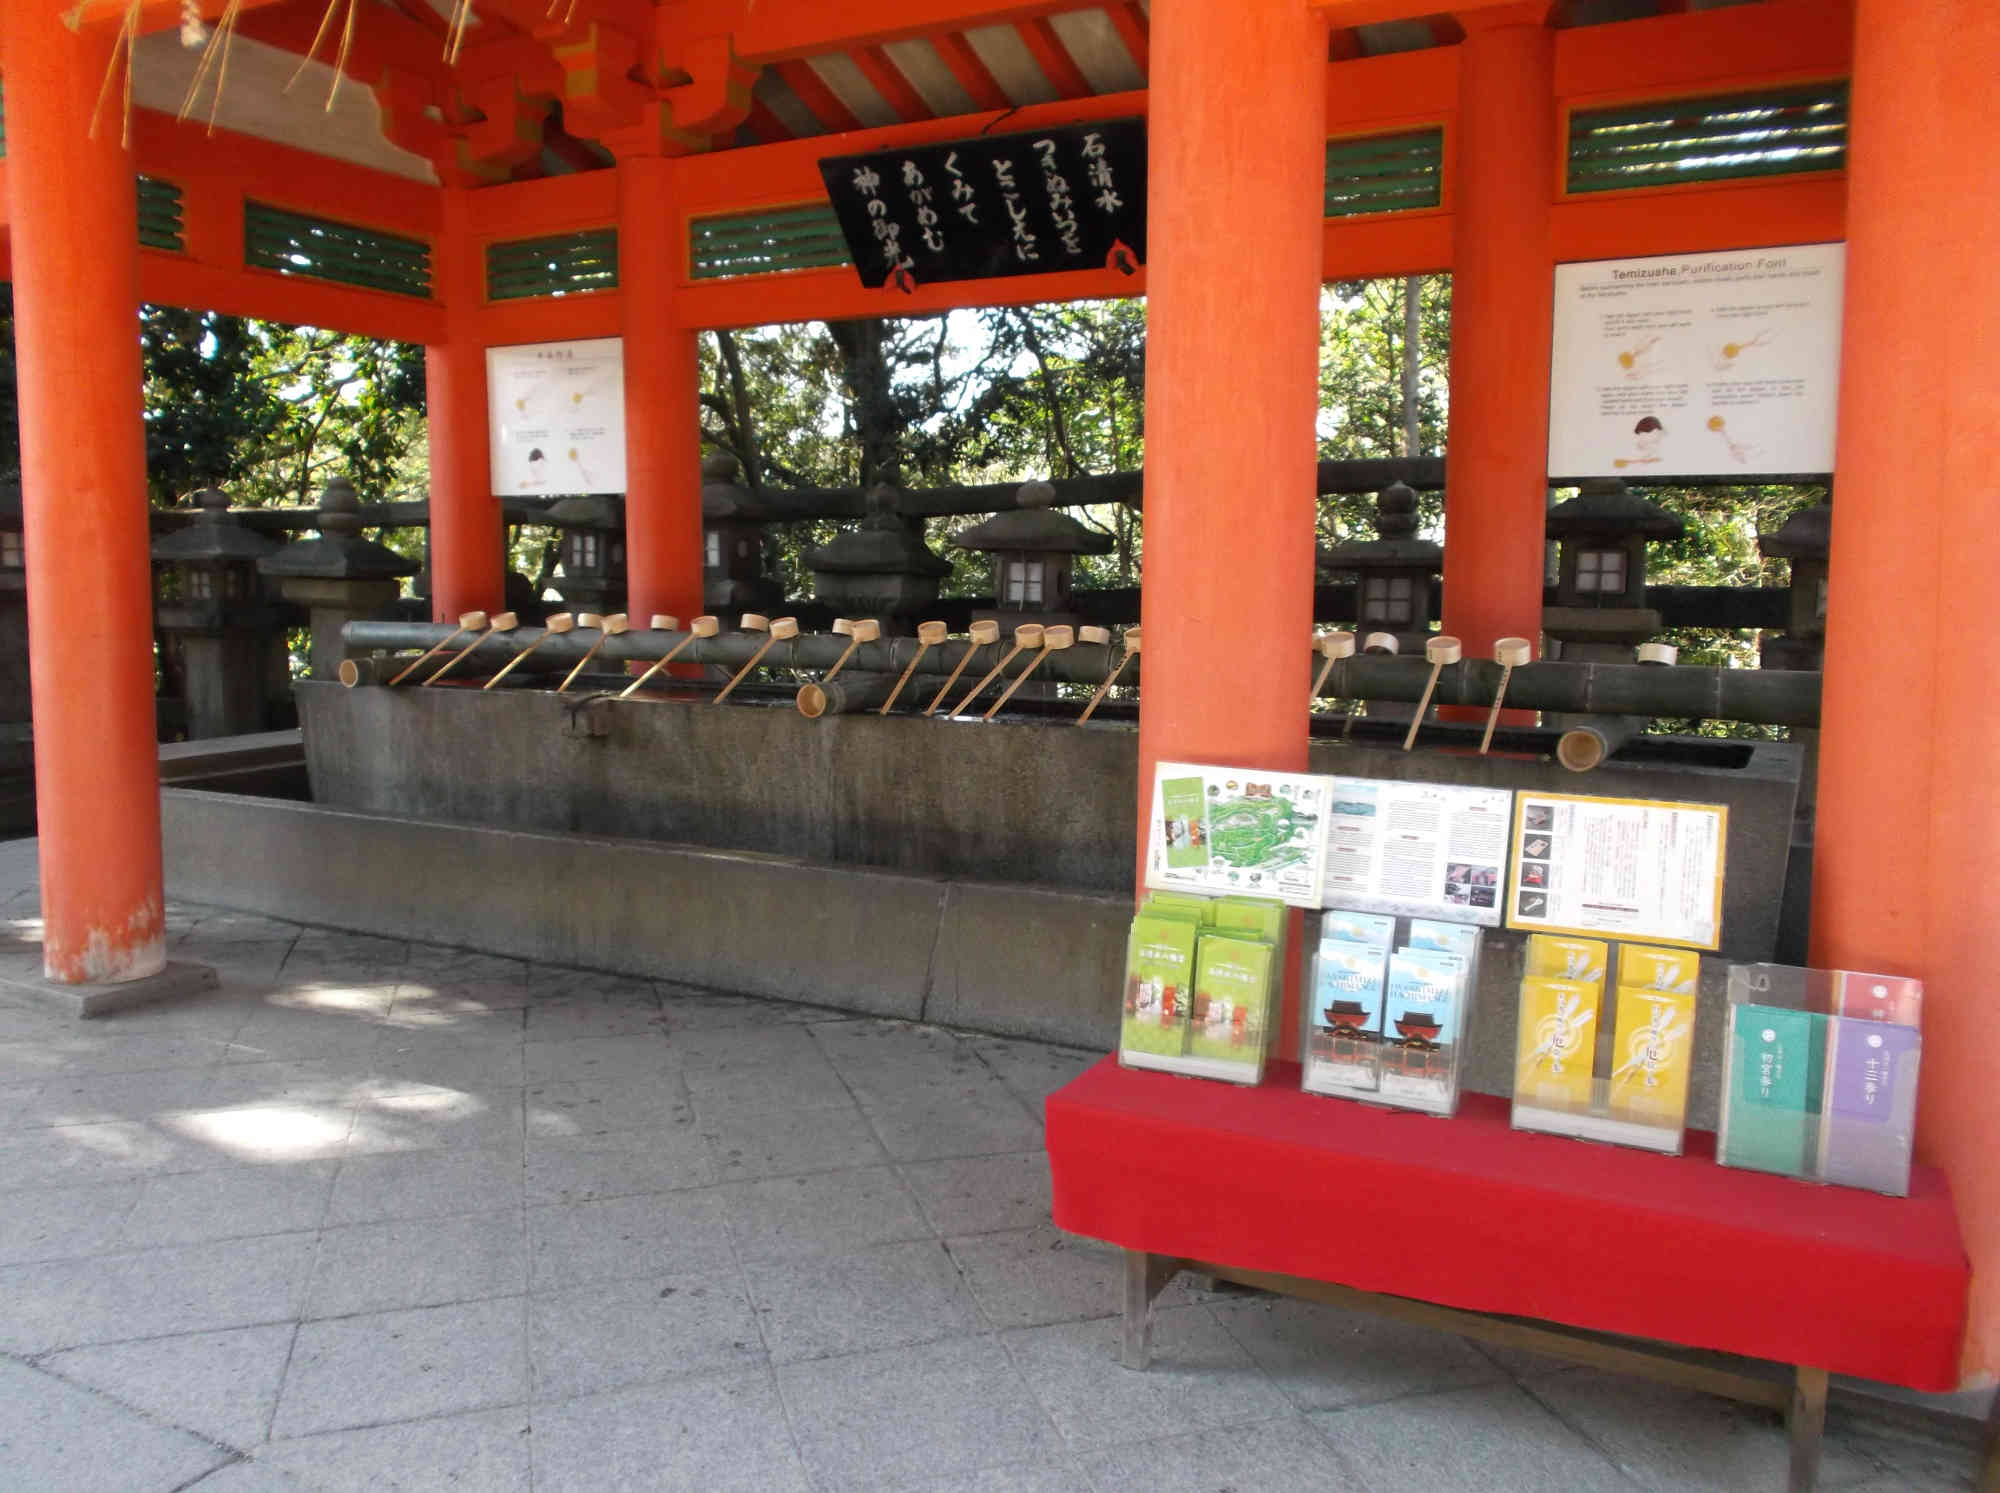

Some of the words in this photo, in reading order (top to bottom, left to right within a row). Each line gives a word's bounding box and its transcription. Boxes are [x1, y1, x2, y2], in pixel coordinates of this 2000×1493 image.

[902, 160, 945, 252] あがめむ
[944, 151, 979, 224] くみて
[1080, 132, 1123, 213] 石清水
